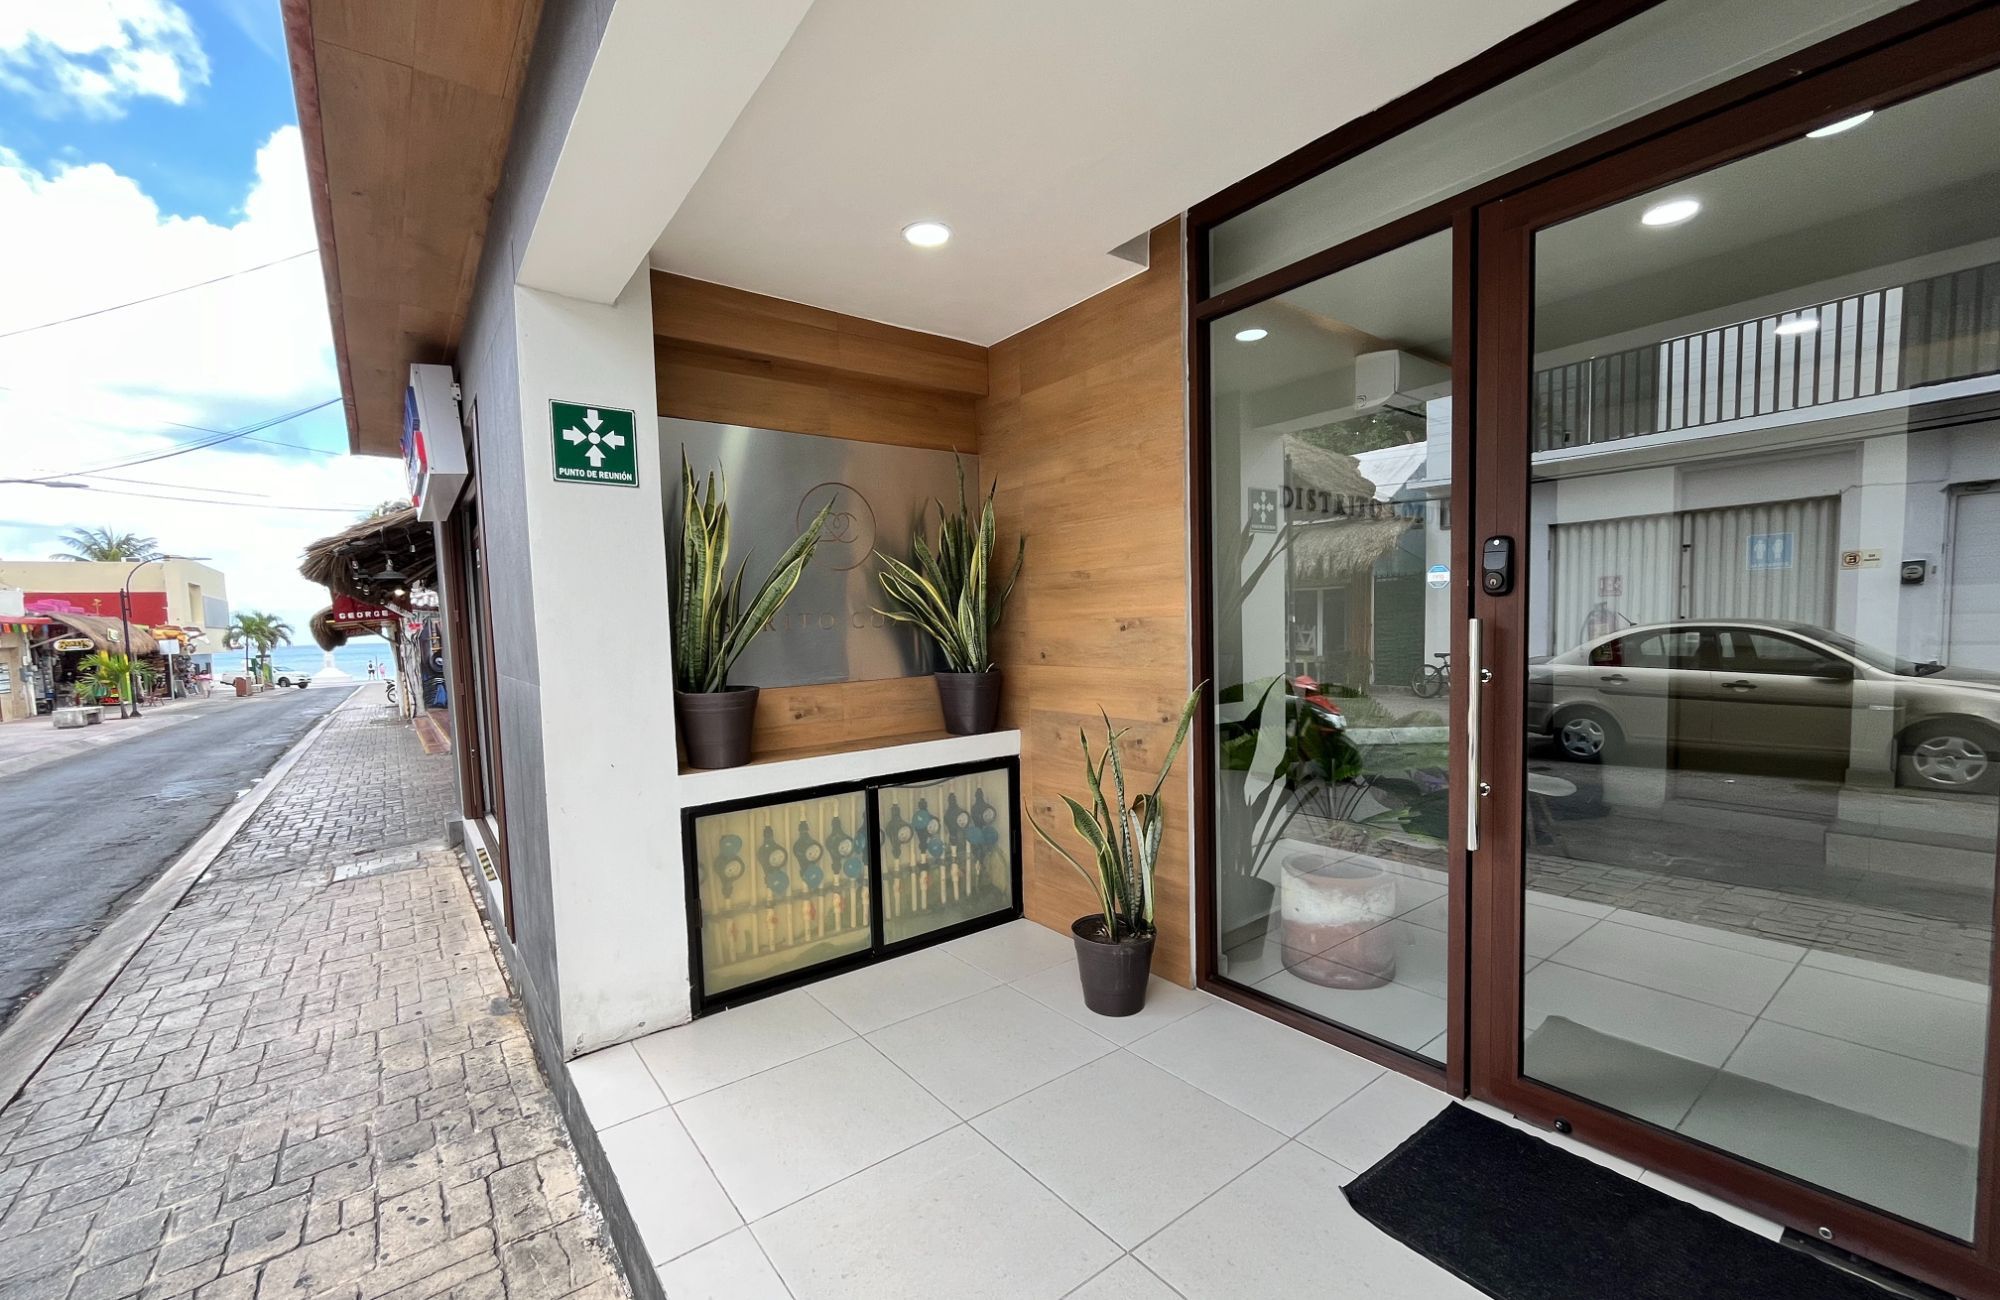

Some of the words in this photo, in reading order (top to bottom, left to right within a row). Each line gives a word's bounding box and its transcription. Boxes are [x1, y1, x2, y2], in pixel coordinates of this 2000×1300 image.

[559, 467, 585, 477] PUNTO
[587, 470, 597, 479] DE
[598, 470, 633, 481] REUNIÓN
[338, 610, 389, 619] GEORGE
